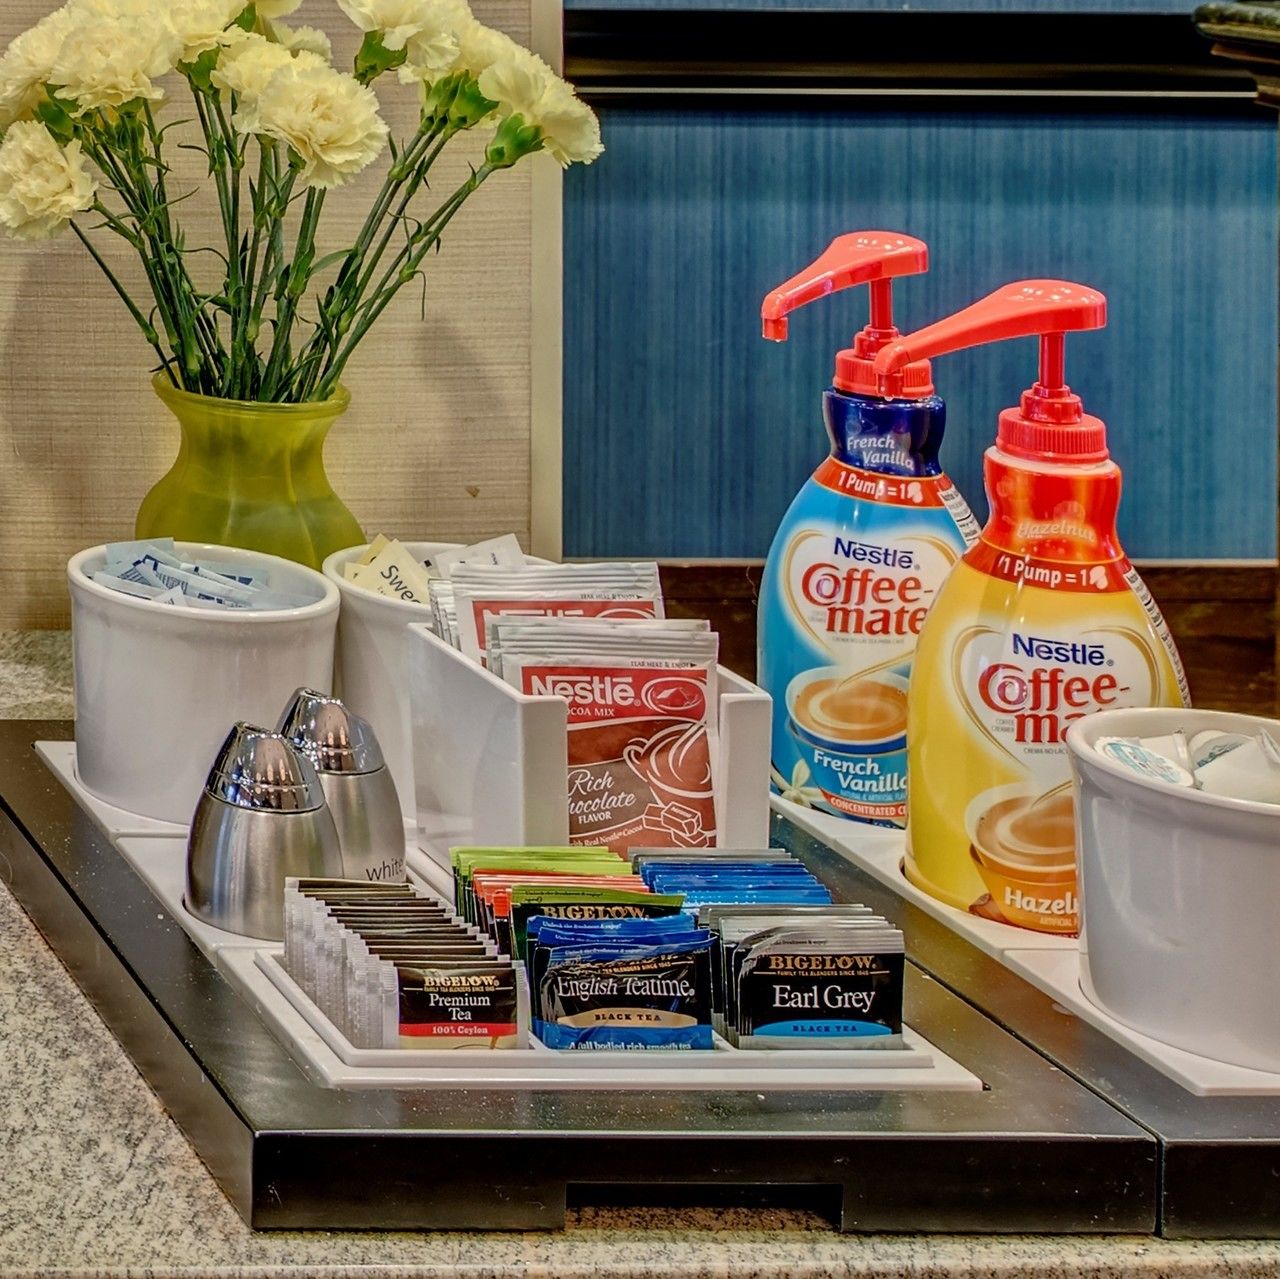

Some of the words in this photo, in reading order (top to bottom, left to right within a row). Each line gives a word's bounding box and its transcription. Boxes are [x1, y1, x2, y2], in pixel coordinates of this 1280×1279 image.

[847, 434, 895, 451] French
[862, 451, 915, 472] Vanilla
[846, 473, 885, 500] Pump
[1017, 520, 1096, 541] Hazelnut
[1014, 560, 1062, 588] Pump
[594, 708, 615, 717] MIX
[813, 749, 881, 776] French
[568, 769, 615, 796] Rich
[830, 797, 896, 816] CONCENTRATED
[578, 811, 613, 824] FLAVOR
[541, 905, 645, 919] BIGELOW
[769, 955, 875, 970] BIGELOW
[424, 975, 496, 987] BIGELOW
[557, 976, 618, 1001] English
[429, 993, 491, 1007] Premium
[772, 985, 820, 1008] Earl
[823, 985, 876, 1013] Grey
[448, 1007, 472, 1020] Tea
[595, 1013, 632, 1021] BLACK
[432, 1025, 455, 1034] 100%
[457, 1025, 488, 1036] Ceylon
[792, 1025, 831, 1033] BLACK
